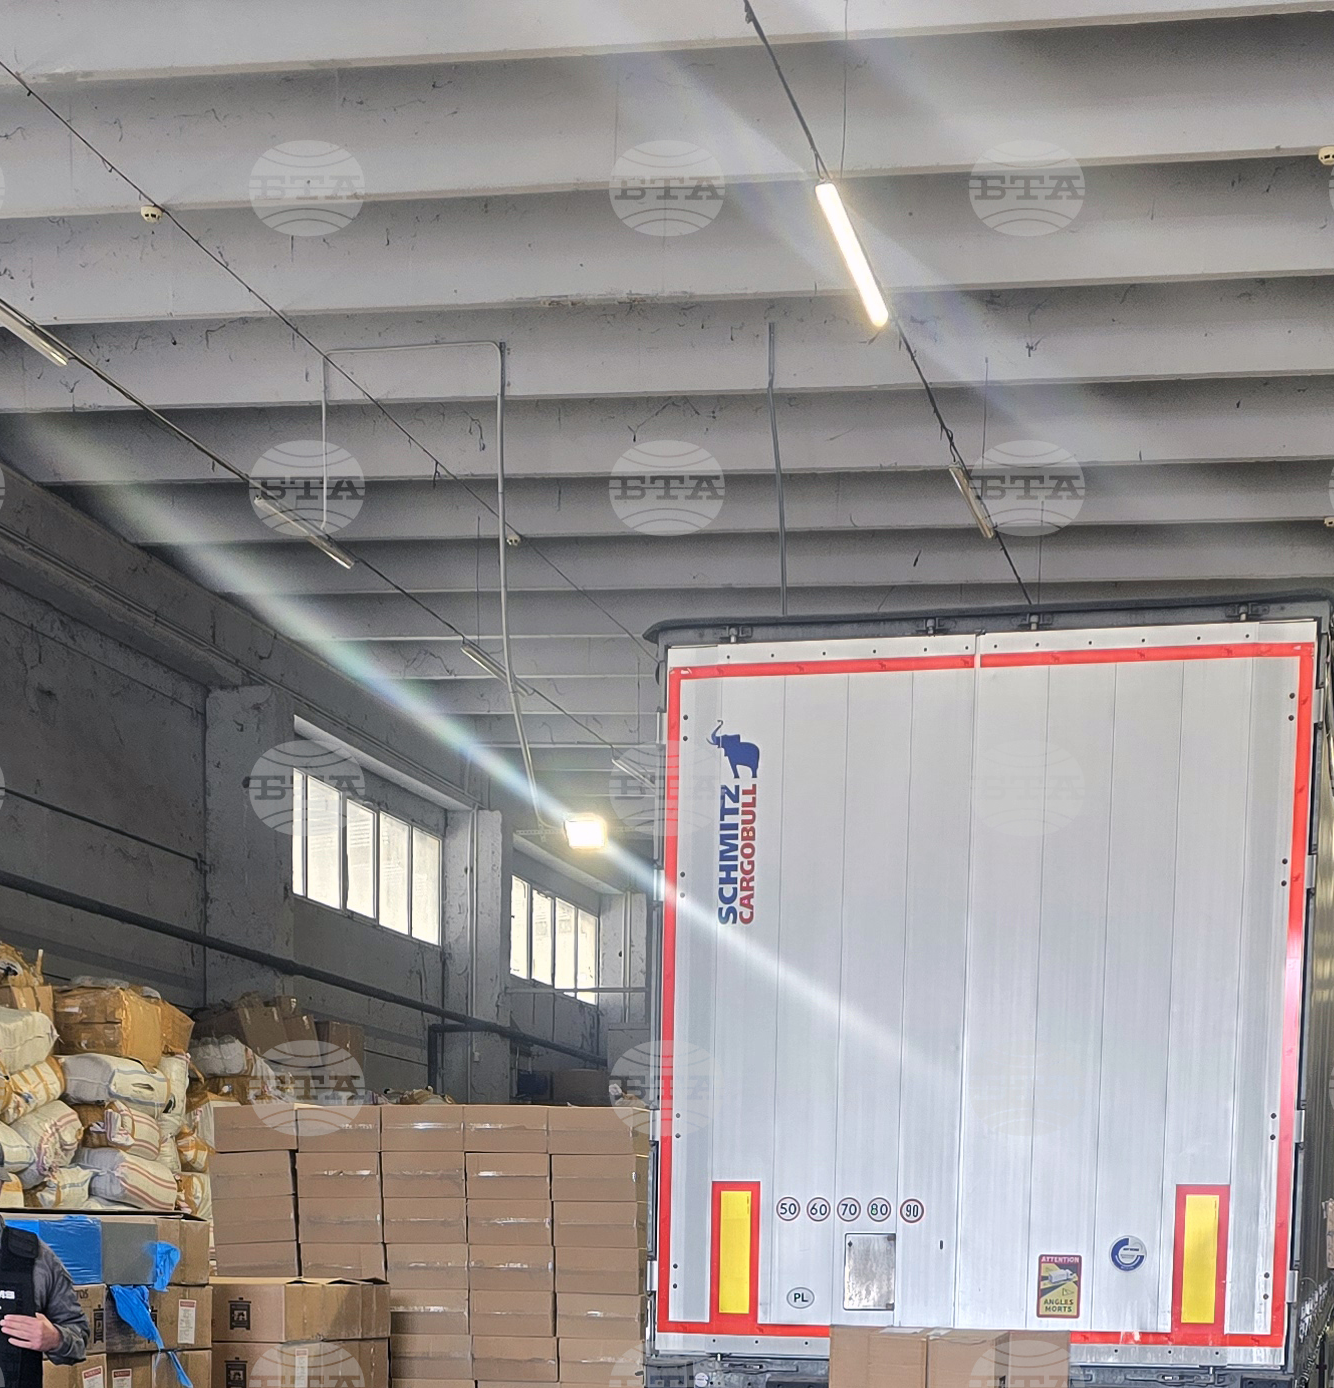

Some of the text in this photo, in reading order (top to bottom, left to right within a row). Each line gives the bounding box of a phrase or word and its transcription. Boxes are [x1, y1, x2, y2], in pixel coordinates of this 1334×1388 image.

[717, 785, 740, 925] SCHMITZ
[739, 784, 757, 925] CARGOBULL
[780, 1203, 919, 1218] 50 60 70 80 90
[793, 1292, 809, 1303] PL
